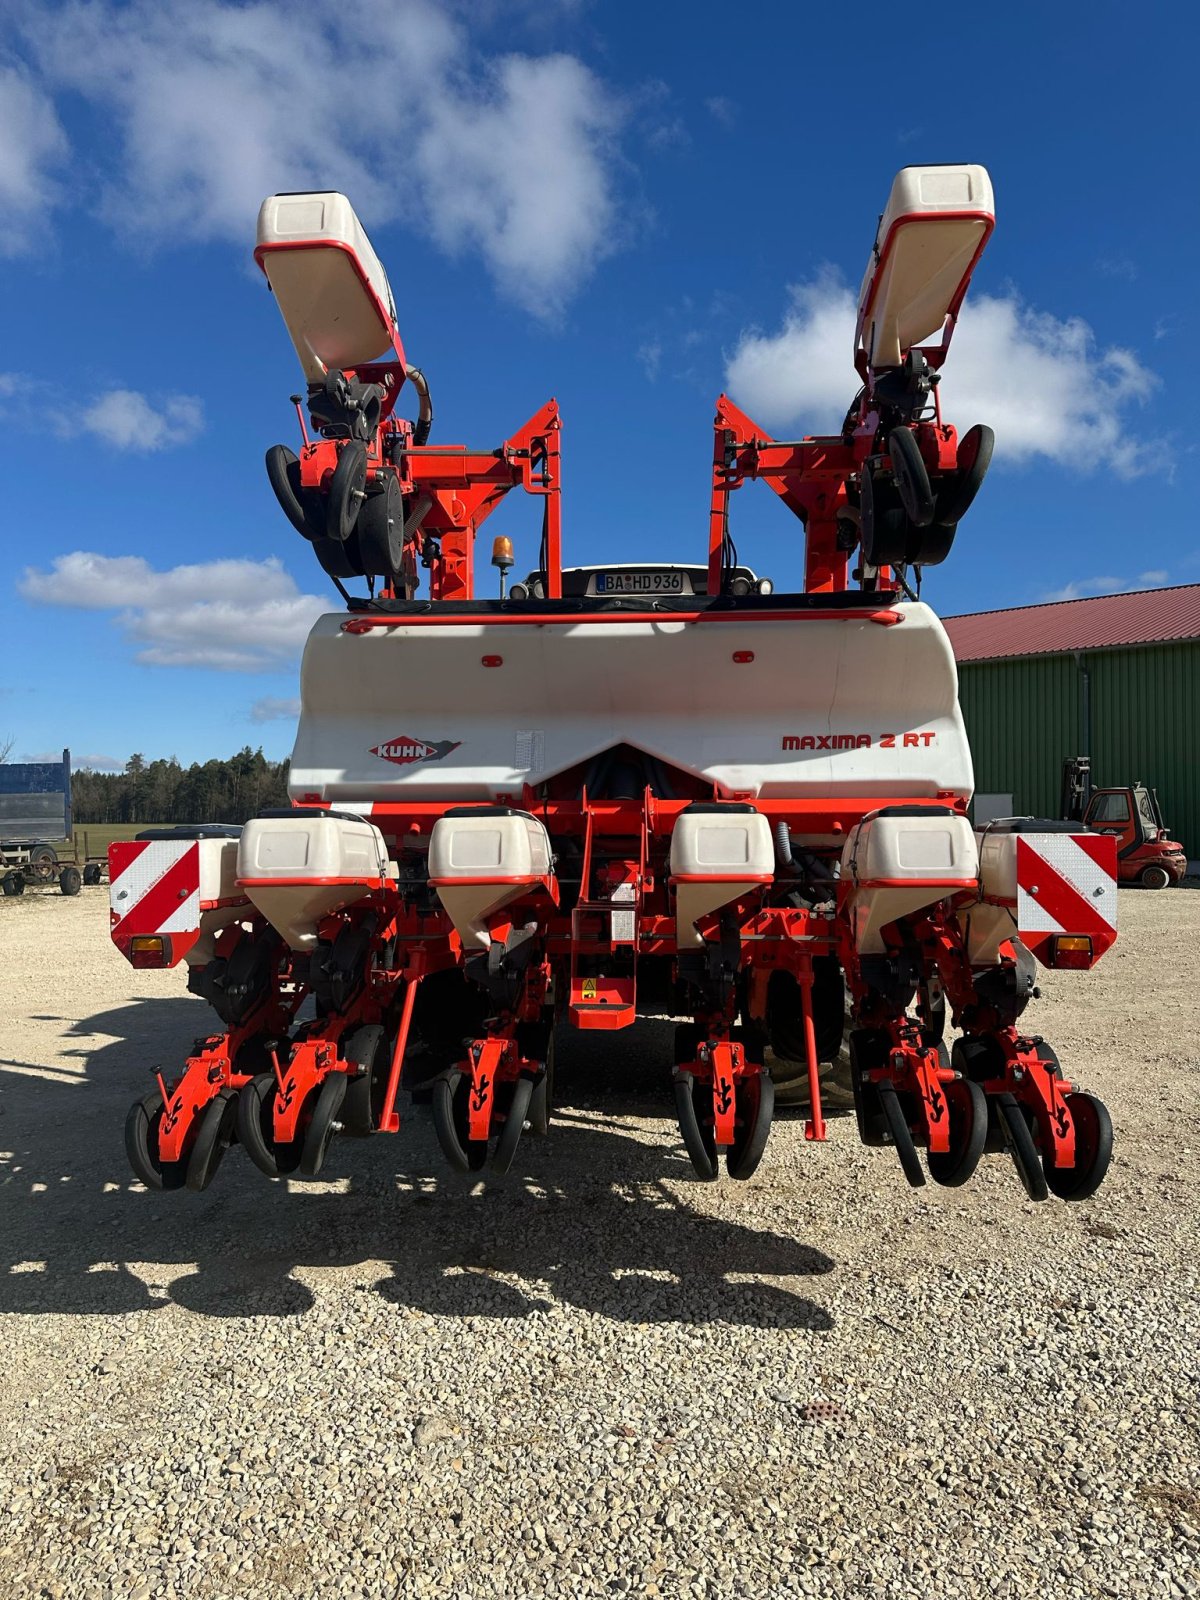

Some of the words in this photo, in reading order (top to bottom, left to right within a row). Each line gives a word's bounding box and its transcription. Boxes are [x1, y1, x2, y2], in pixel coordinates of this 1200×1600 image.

[606, 576, 624, 590] BA
[633, 575, 651, 589] HD
[653, 575, 680, 589] 936
[782, 734, 872, 750] MAXIMA
[879, 733, 895, 748] 2
[903, 732, 936, 747] RT
[377, 745, 427, 757] KUHN
